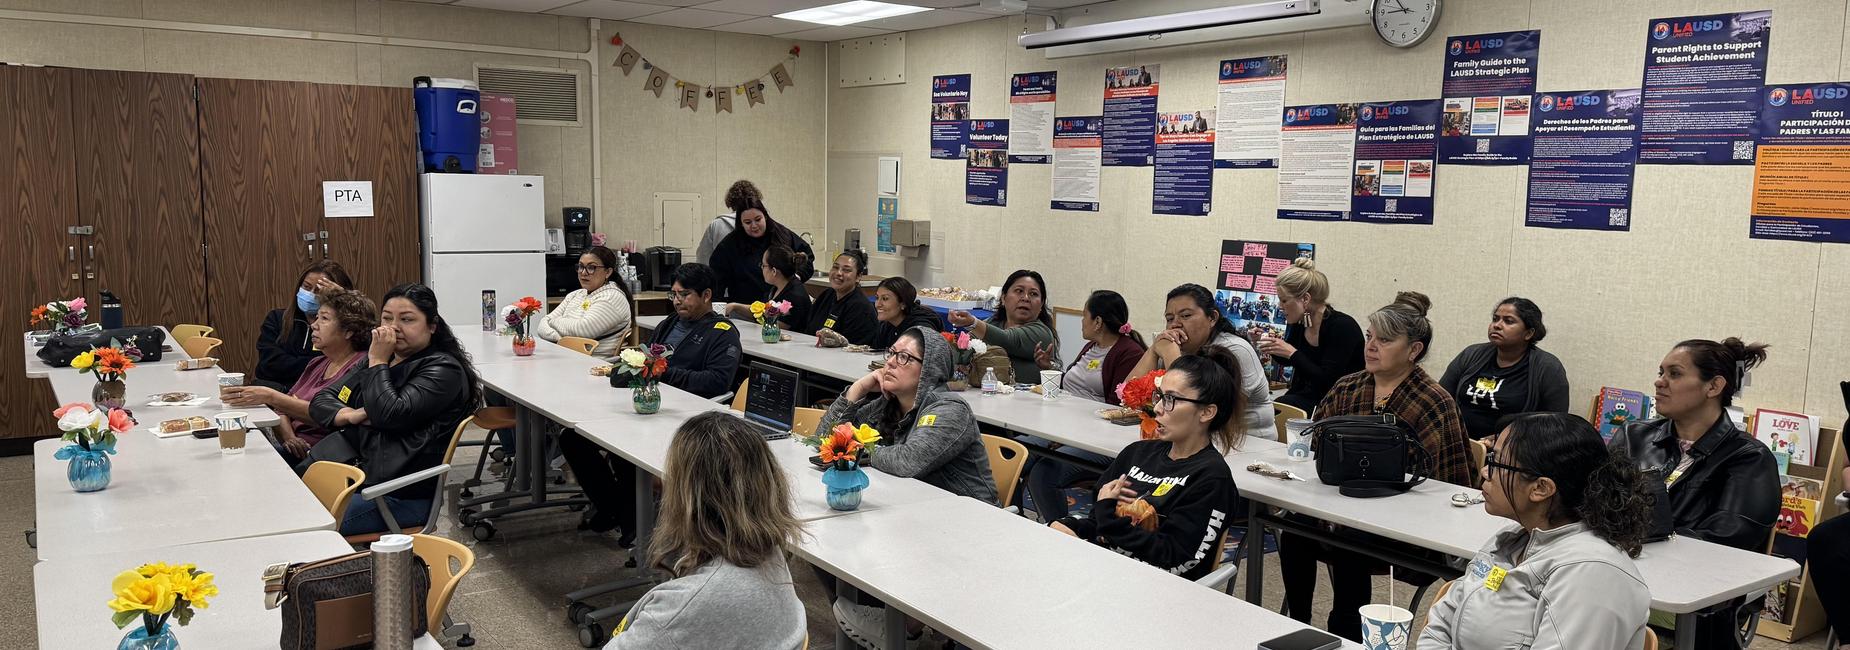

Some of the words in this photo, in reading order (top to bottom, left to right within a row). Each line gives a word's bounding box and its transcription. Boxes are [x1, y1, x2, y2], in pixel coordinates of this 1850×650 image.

[1673, 20, 1723, 33] LAUSD
[1466, 39, 1504, 50] LAUSD
[1682, 44, 1711, 54] Rights
[1724, 41, 1762, 50] Support
[1656, 55, 1691, 63] Student
[1692, 52, 1755, 62] Achievement
[1233, 61, 1260, 70] LAUSD
[1454, 60, 1479, 68] Family
[1117, 68, 1139, 76] LAUSD
[1475, 68, 1510, 76] Strategic
[1792, 88, 1848, 99] LAUSD
[1557, 96, 1600, 106] LAUSD
[1298, 108, 1328, 117] LAUSD
[1375, 107, 1409, 115] LAUSD
[1781, 118, 1844, 126] PARTICIPACIÓN
[993, 134, 1008, 142] Today
[1372, 134, 1406, 142] Estratégico
[335, 190, 362, 202] PTA
[1772, 419, 1799, 431] LOVE
